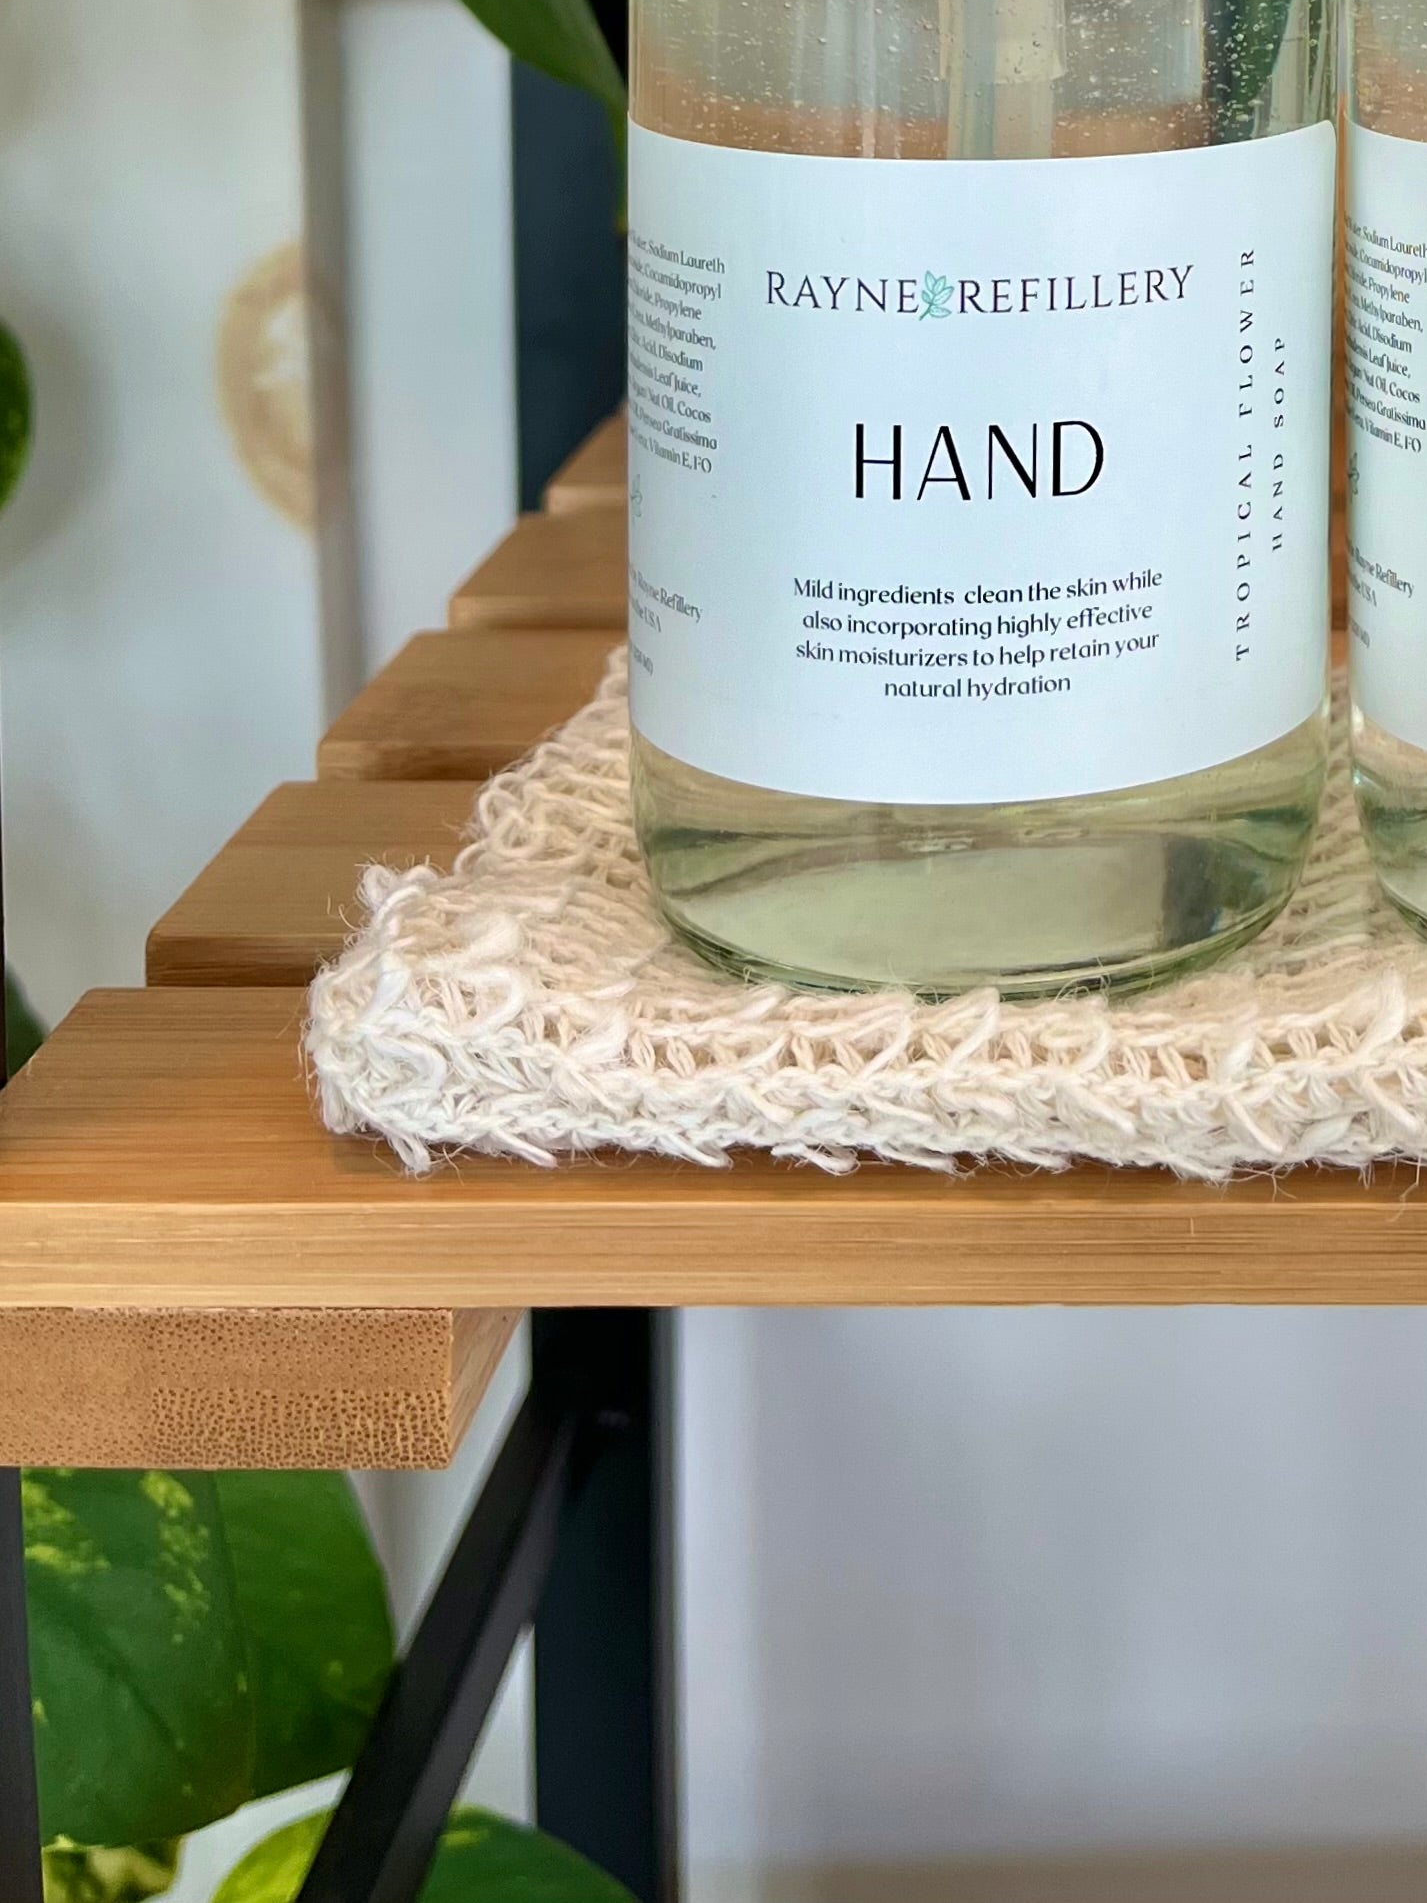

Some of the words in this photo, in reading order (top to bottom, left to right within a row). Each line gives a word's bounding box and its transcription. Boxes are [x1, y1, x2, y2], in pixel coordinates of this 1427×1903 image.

[648, 240, 680, 264] Sodium
[680, 250, 725, 274] Laureth
[655, 292, 702, 320] Propylene
[765, 269, 920, 314] RAYNE
[957, 263, 1195, 315] REFILLERY
[1368, 277, 1409, 304] Propylene
[1238, 249, 1255, 419] FLOWER
[1372, 326, 1412, 353] Disodium
[658, 344, 704, 371] Disodium
[1369, 347, 1386, 369] Leaf
[1386, 356, 1411, 379] Juice,
[654, 367, 675, 387] Leaf
[674, 375, 701, 397] Juice,
[1273, 337, 1286, 429] SOAP
[1389, 381, 1420, 403] Cocos
[677, 400, 711, 423] Cocos
[1377, 400, 1426, 430] Gratissima
[662, 419, 717, 450] Gratissima
[854, 420, 1105, 502] HAND
[1271, 453, 1284, 553] HAND
[1235, 443, 1253, 662] TROPICAL
[793, 577, 834, 600] Mild
[837, 581, 955, 608] ingredients
[963, 583, 1024, 605] clean
[1027, 581, 1062, 603] the
[1065, 577, 1108, 599] skin
[1111, 567, 1163, 593] while
[1376, 562, 1413, 598] Refillery
[660, 587, 701, 624] Refillery
[802, 609, 843, 633] also
[847, 613, 993, 641] incorporating
[996, 611, 1063, 639] highly
[1066, 603, 1153, 630] effective
[795, 639, 835, 663] skin
[838, 646, 969, 668] moisturizers
[972, 649, 995, 667] to
[999, 643, 1046, 669] help
[1049, 638, 1111, 663] retain
[1114, 633, 1160, 659] your
[884, 677, 962, 698] natural
[966, 674, 1071, 702] hydration
